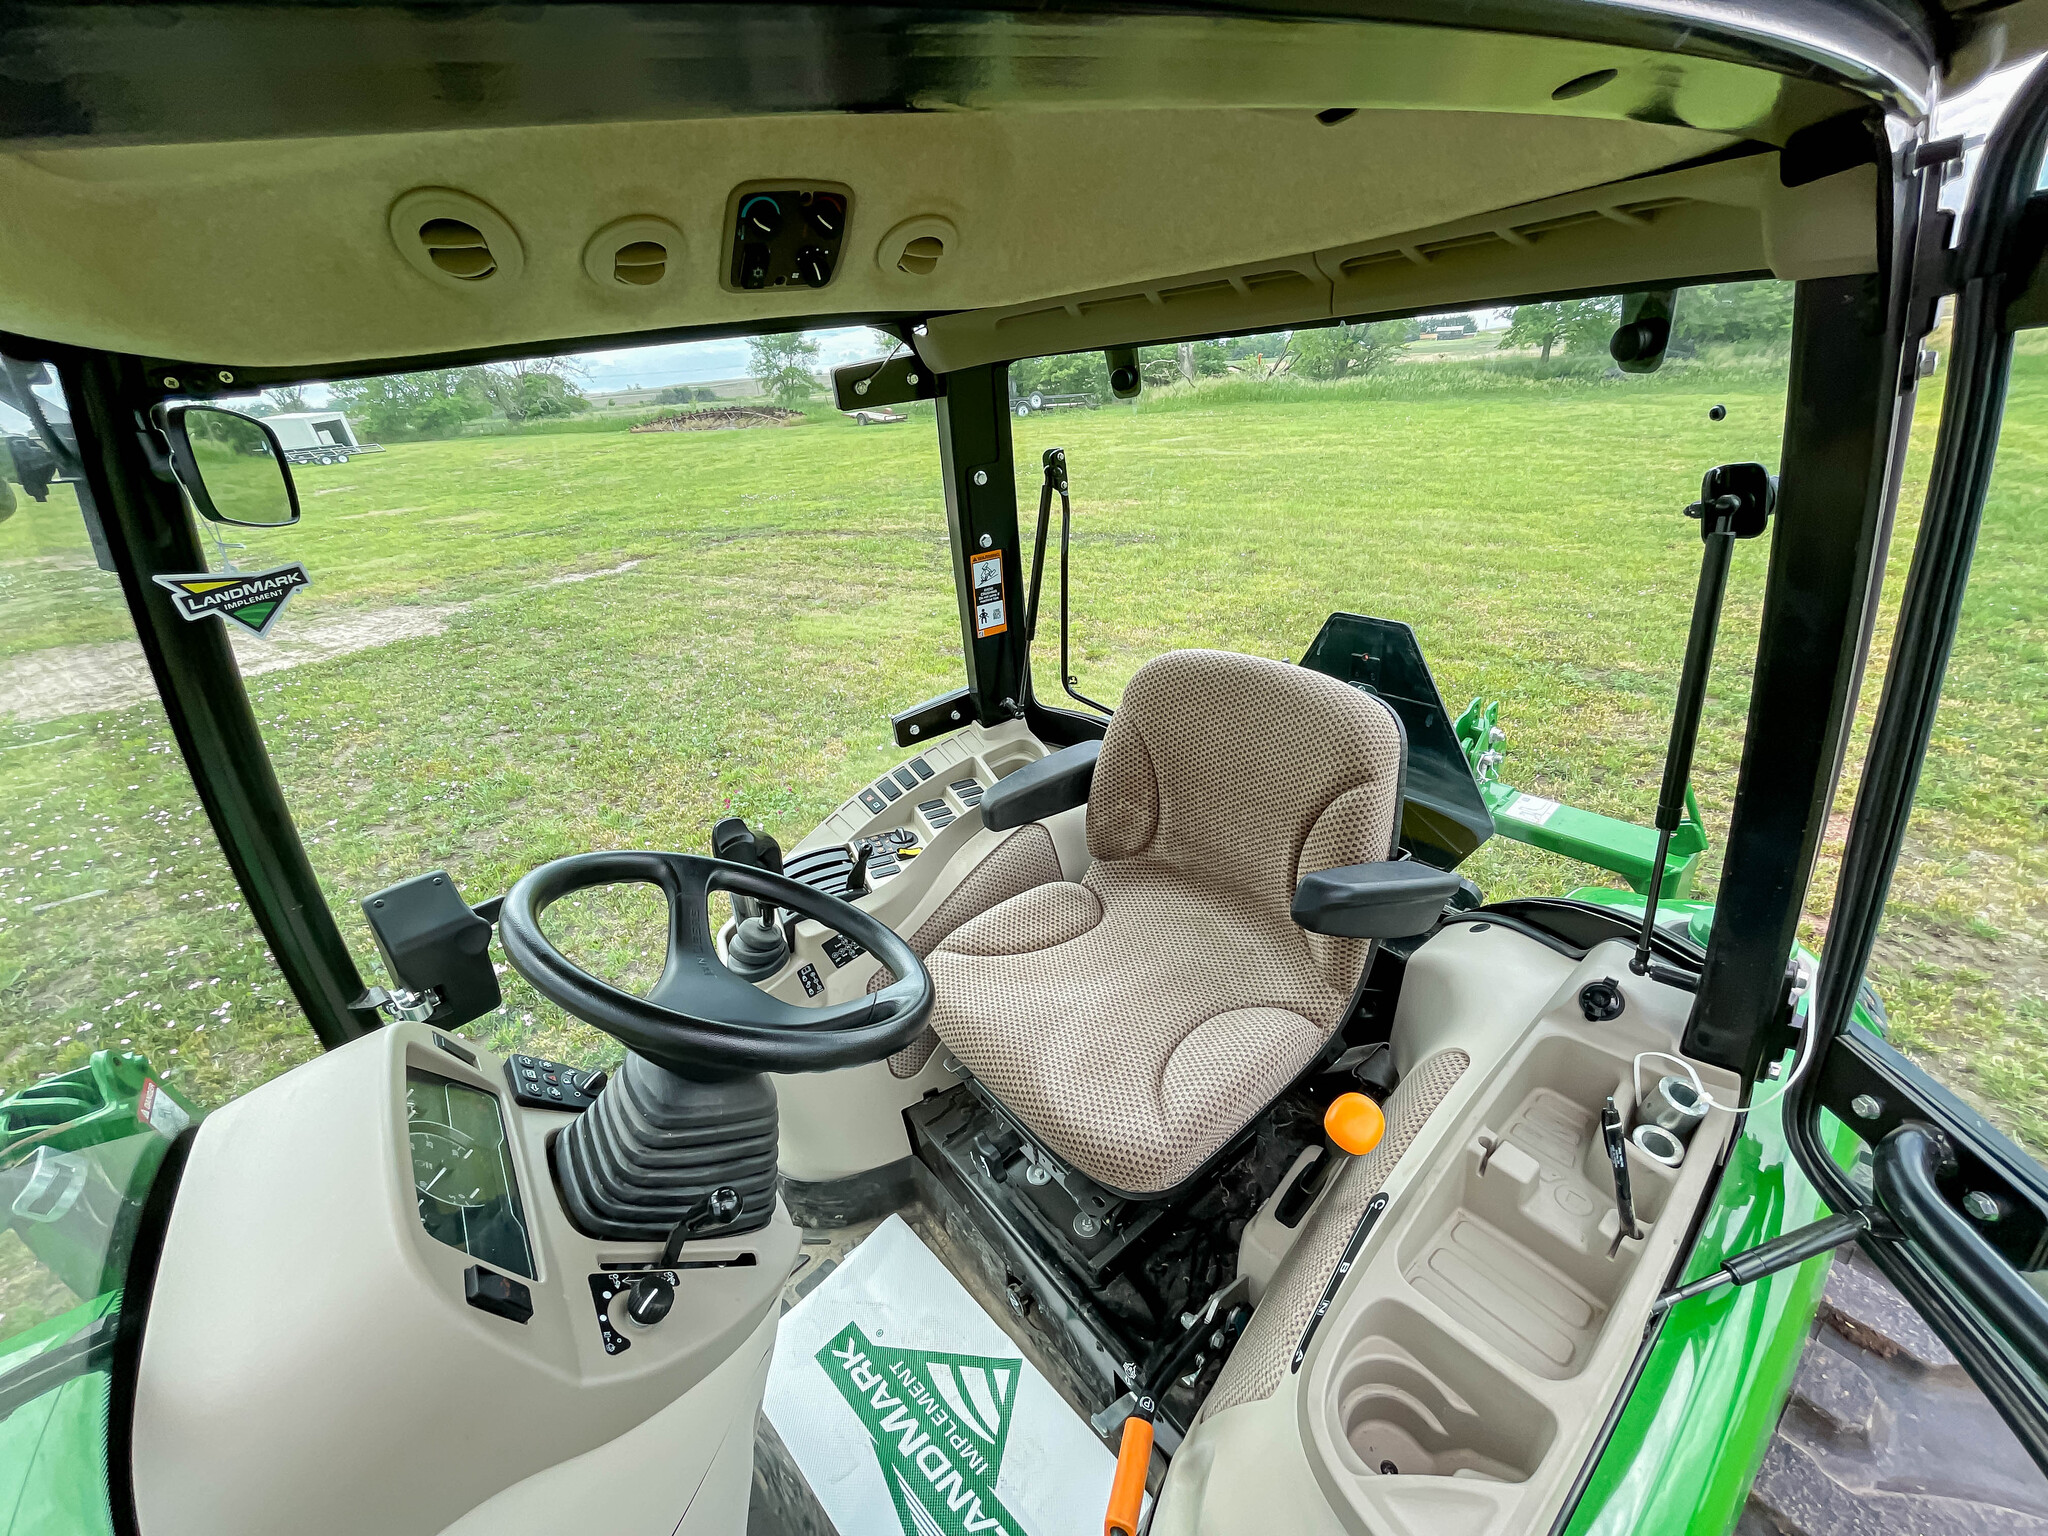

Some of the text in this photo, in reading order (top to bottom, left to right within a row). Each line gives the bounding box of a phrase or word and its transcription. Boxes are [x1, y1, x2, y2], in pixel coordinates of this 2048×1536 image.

[187, 572, 302, 610] LANDMARK
[224, 588, 284, 611] IMPLEMENT
[1374, 1199, 1386, 1211] C
[1339, 1262, 1351, 1274] B
[1296, 1349, 1304, 1363] A
[889, 1360, 989, 1476] IMPLEMENT
